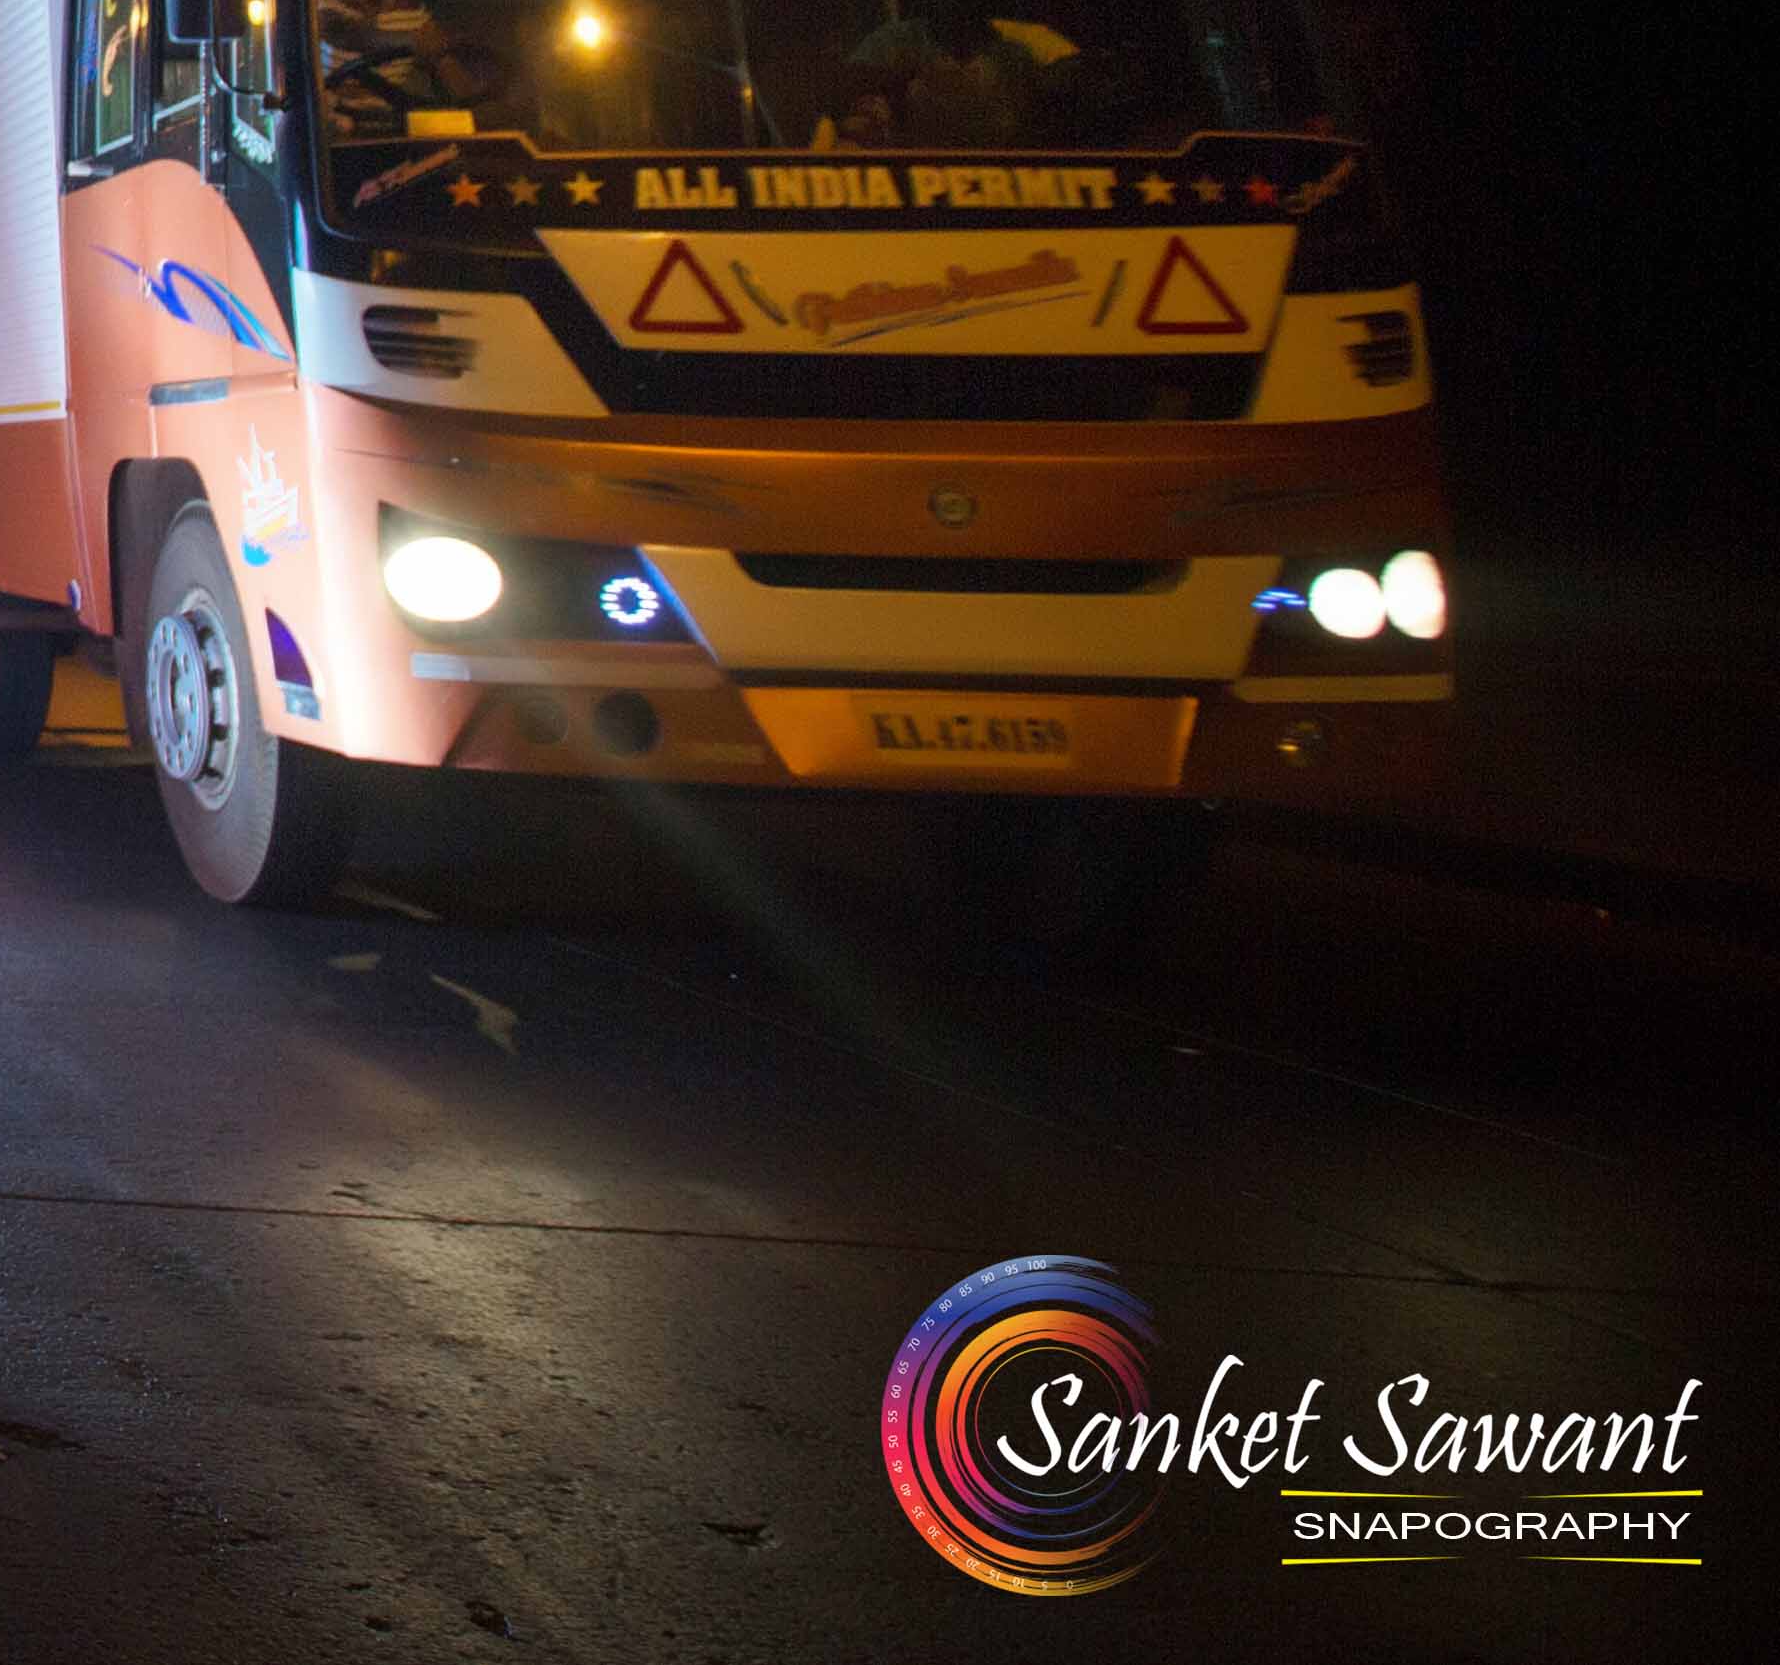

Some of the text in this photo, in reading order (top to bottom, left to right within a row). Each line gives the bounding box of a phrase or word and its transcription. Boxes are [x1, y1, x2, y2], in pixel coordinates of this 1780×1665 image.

[636, 166, 1117, 210] ALL INDIA PERMIT
